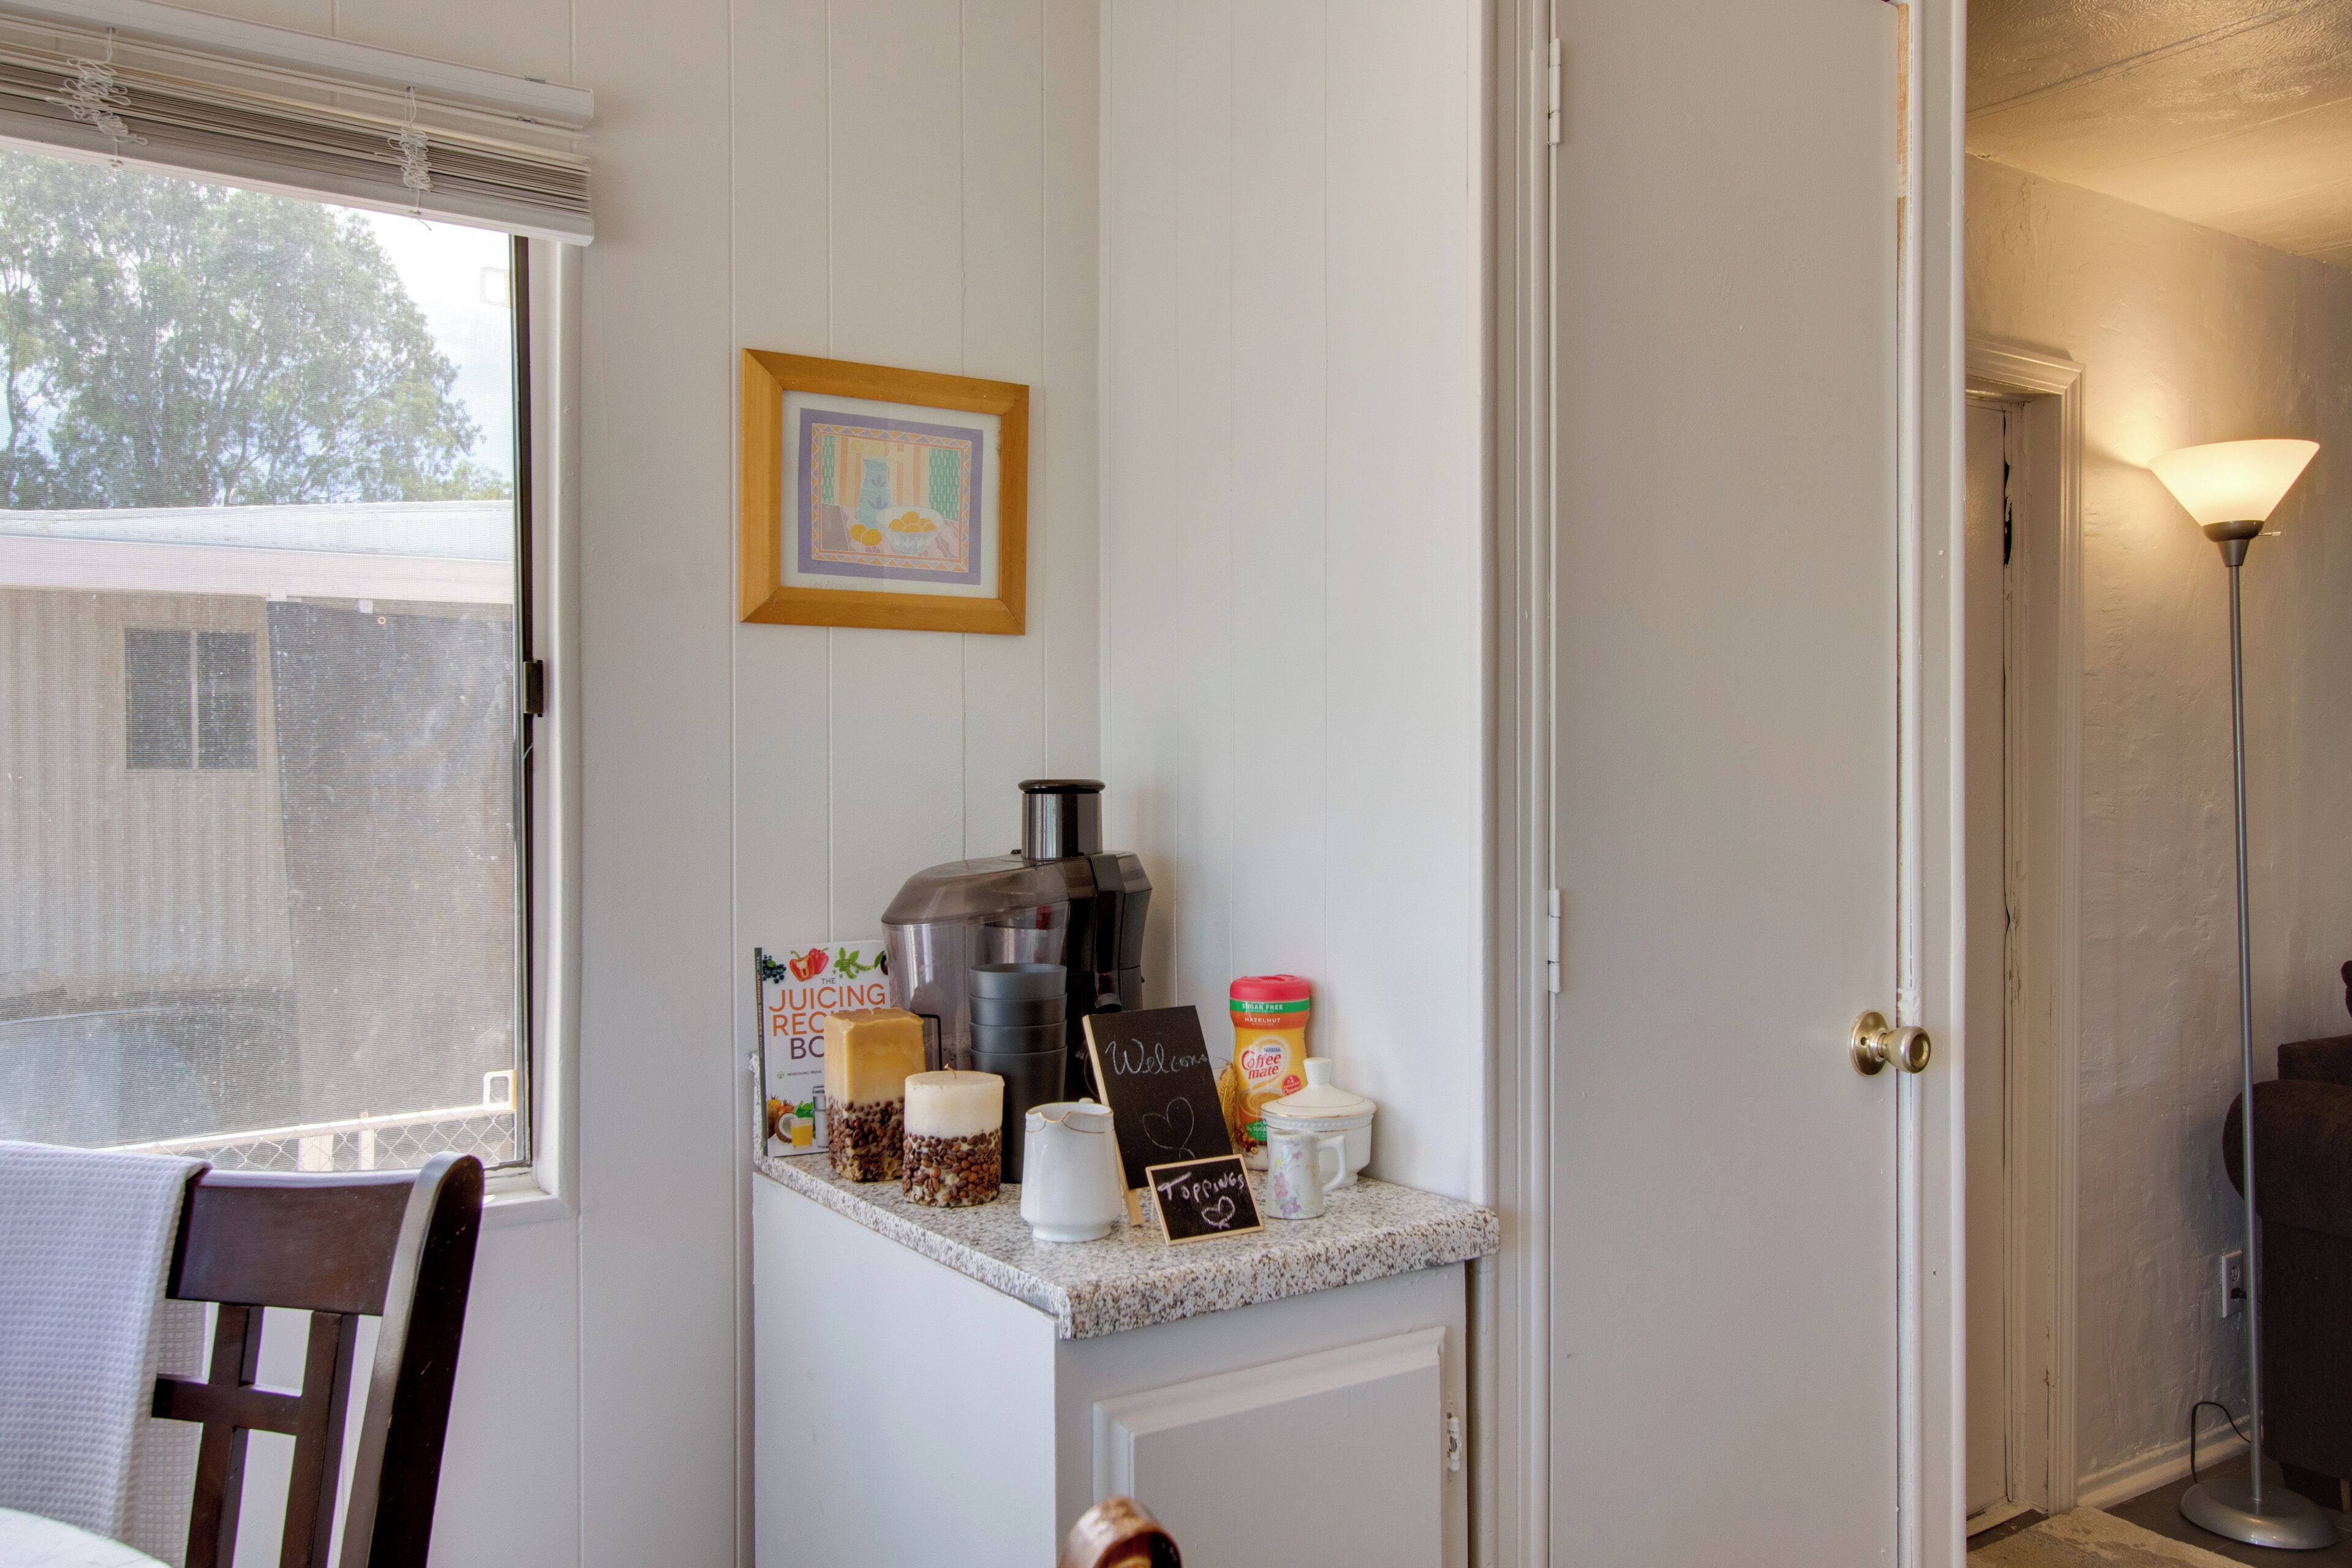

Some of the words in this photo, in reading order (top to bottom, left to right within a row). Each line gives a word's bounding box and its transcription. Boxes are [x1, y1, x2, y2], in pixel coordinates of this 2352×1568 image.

[769, 983, 886, 1012] JUICING
[790, 1035, 824, 1059] BO
[1242, 1050, 1281, 1071] Coffee
[1248, 1066, 1279, 1079] mate
